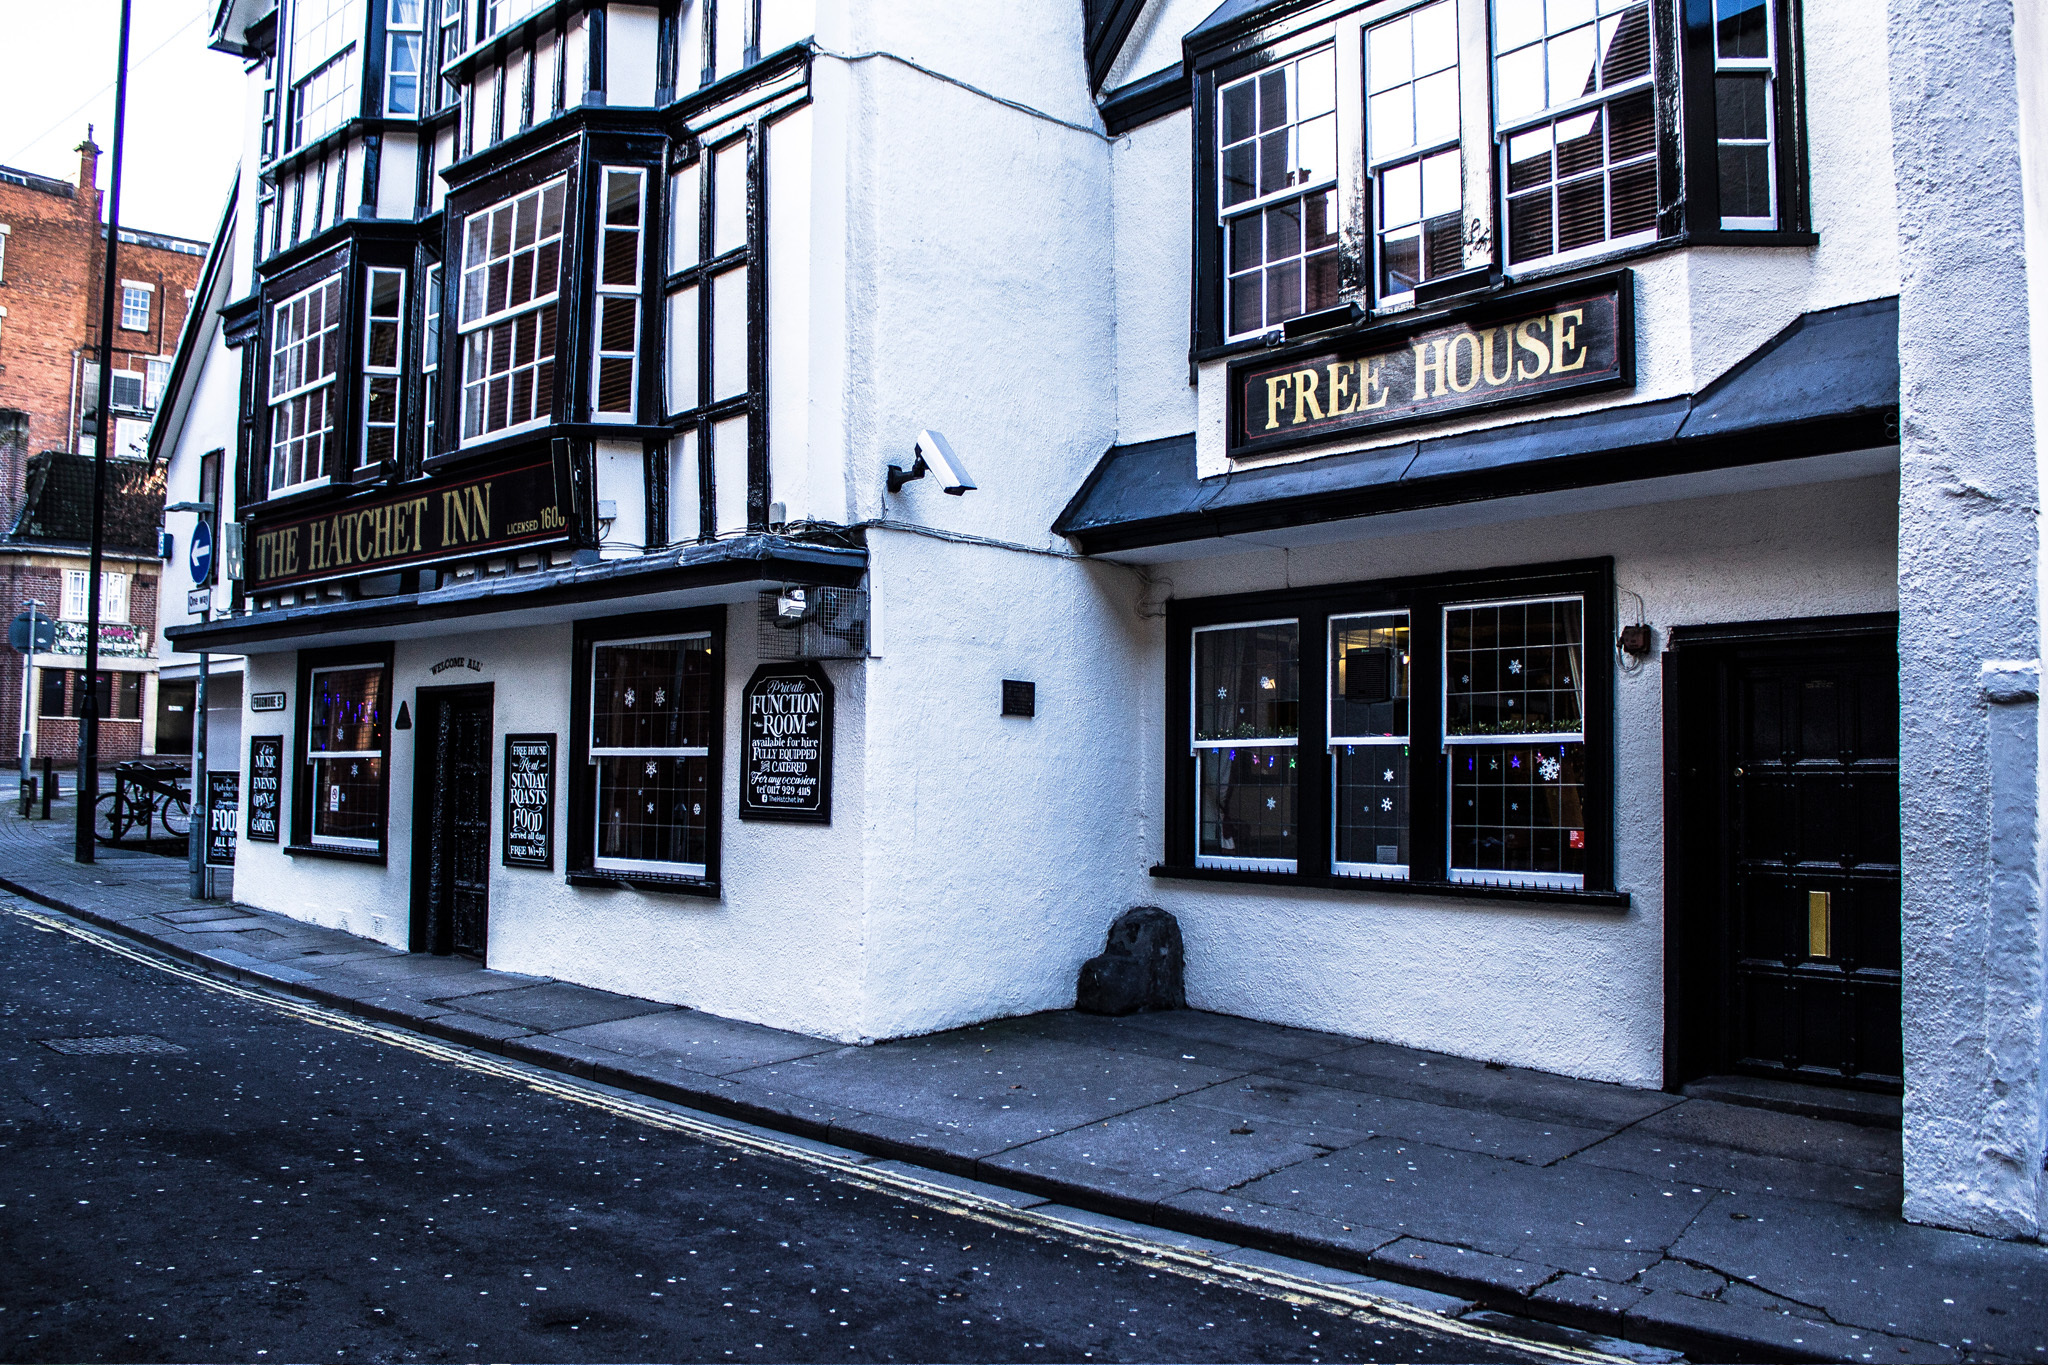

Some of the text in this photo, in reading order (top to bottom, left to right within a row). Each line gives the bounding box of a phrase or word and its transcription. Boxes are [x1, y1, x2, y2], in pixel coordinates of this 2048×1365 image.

[1265, 308, 1588, 430] FREE HOUSE
[256, 482, 492, 581] THE HATCHET INN
[507, 519, 539, 535] LICENSED
[767, 680, 806, 694] Private
[752, 693, 821, 715] FUNCTION
[763, 714, 807, 737] ROOM
[752, 737, 819, 748] available for hire
[513, 745, 547, 757] FREE HOUSE
[752, 747, 817, 761] FULLY EQUIPPED
[255, 755, 277, 769] MUSIC
[519, 756, 540, 773] Real
[771, 760, 808, 776] CATERED
[253, 776, 277, 790] EVENTS
[511, 772, 549, 789] SUNDAY
[751, 771, 817, 786] For any occasion
[510, 788, 547, 807] ROASTS
[766, 785, 781, 795] 0117
[781, 785, 796, 796] 929
[251, 818, 276, 833] GARDEN
[513, 808, 543, 832] FOOD
[214, 836, 226, 847] ALL
[510, 831, 527, 840] served
[534, 832, 546, 847] day
[510, 845, 527, 856] FREE
